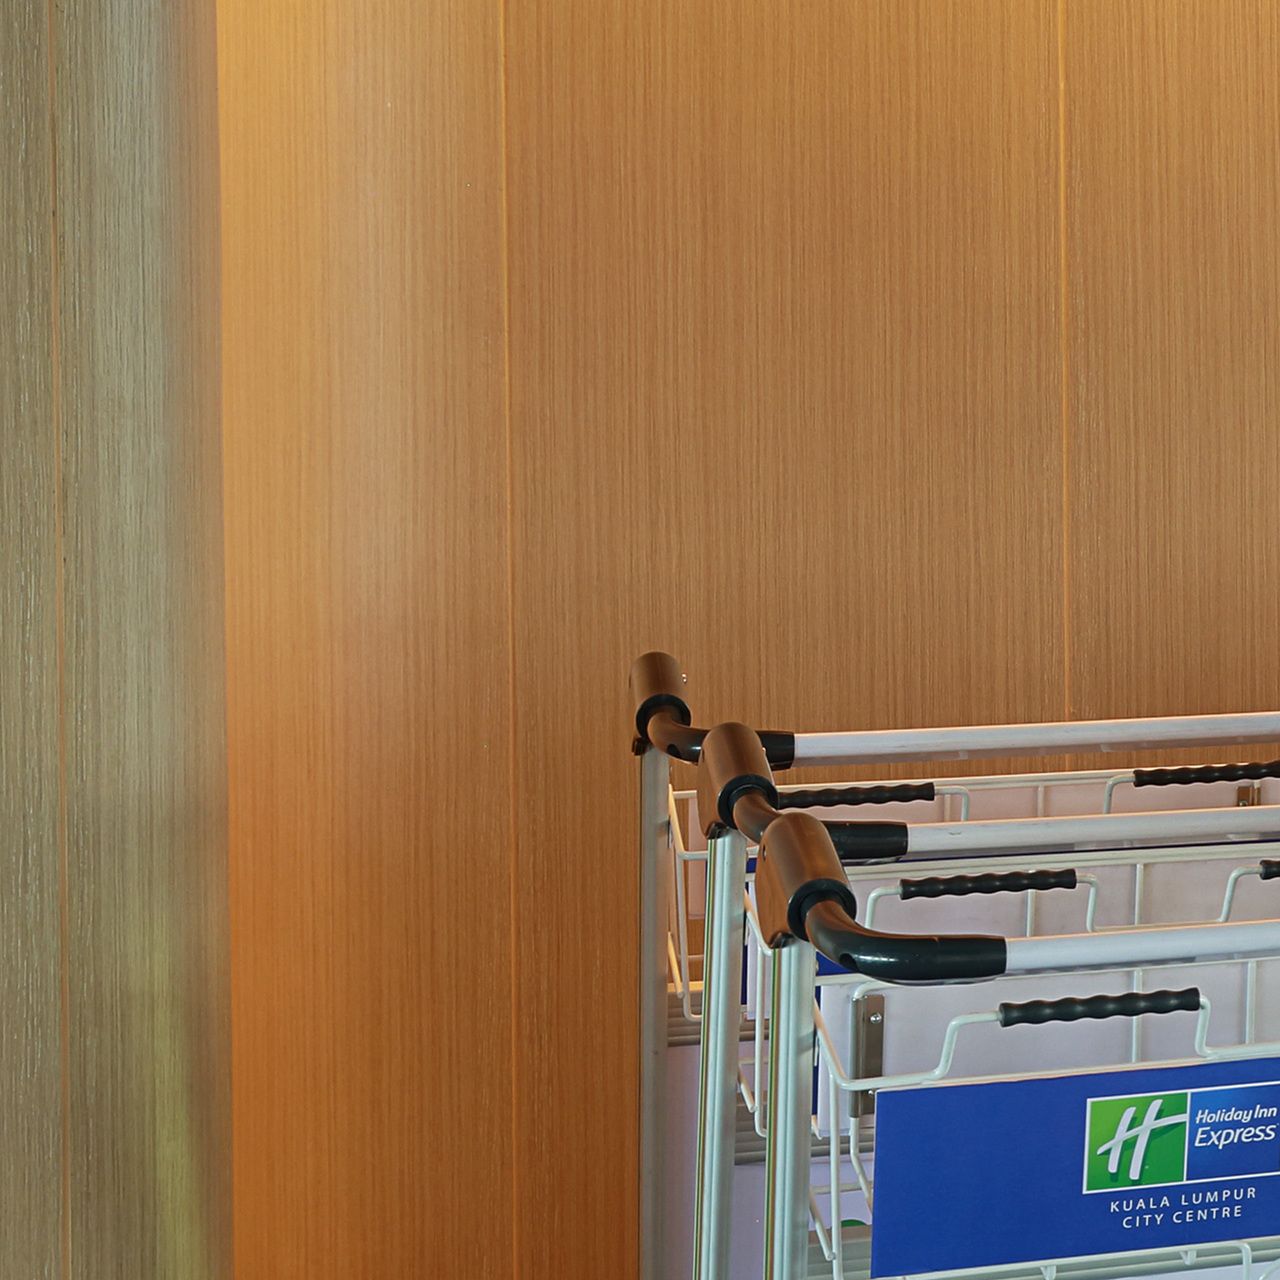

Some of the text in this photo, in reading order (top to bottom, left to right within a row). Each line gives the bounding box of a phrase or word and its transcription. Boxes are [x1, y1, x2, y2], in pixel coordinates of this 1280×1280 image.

[1196, 1104, 1277, 1124] Holiday Inn
[1194, 1125, 1276, 1149] Express
[1110, 1187, 1255, 1212] KUALA LUMPUR
[1123, 1205, 1241, 1228] CITY CENTRE
